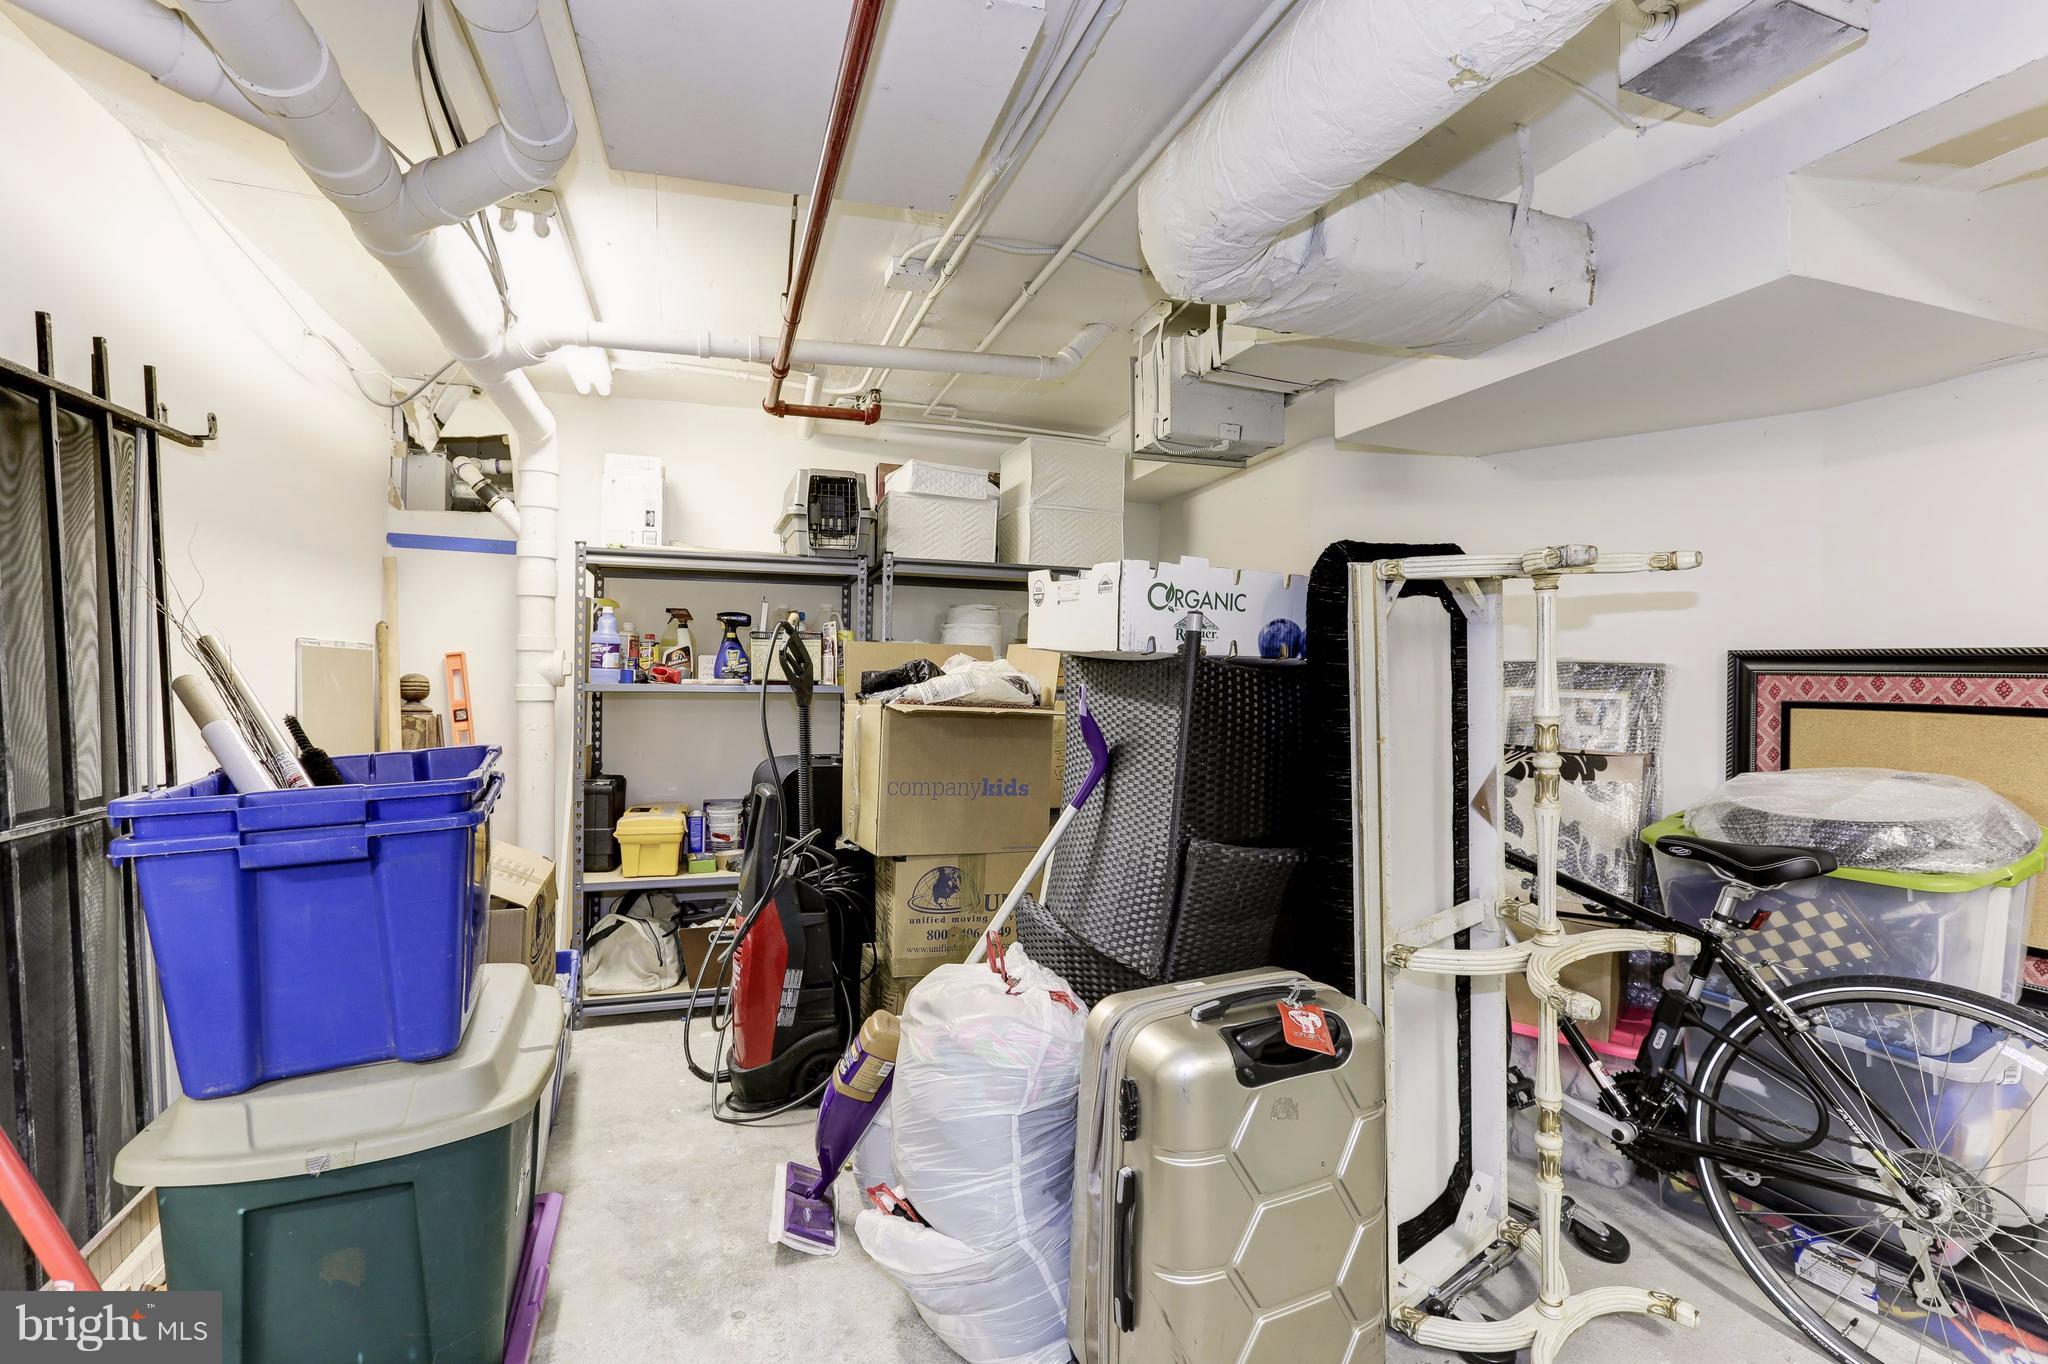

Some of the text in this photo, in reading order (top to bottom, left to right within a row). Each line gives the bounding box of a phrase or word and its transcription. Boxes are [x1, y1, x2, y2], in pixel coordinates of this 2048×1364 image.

[1147, 582, 1247, 613] ORGANIC
[887, 777, 1029, 800] companykids
[909, 915, 989, 925] unified moving
[926, 929, 948, 941] 800
